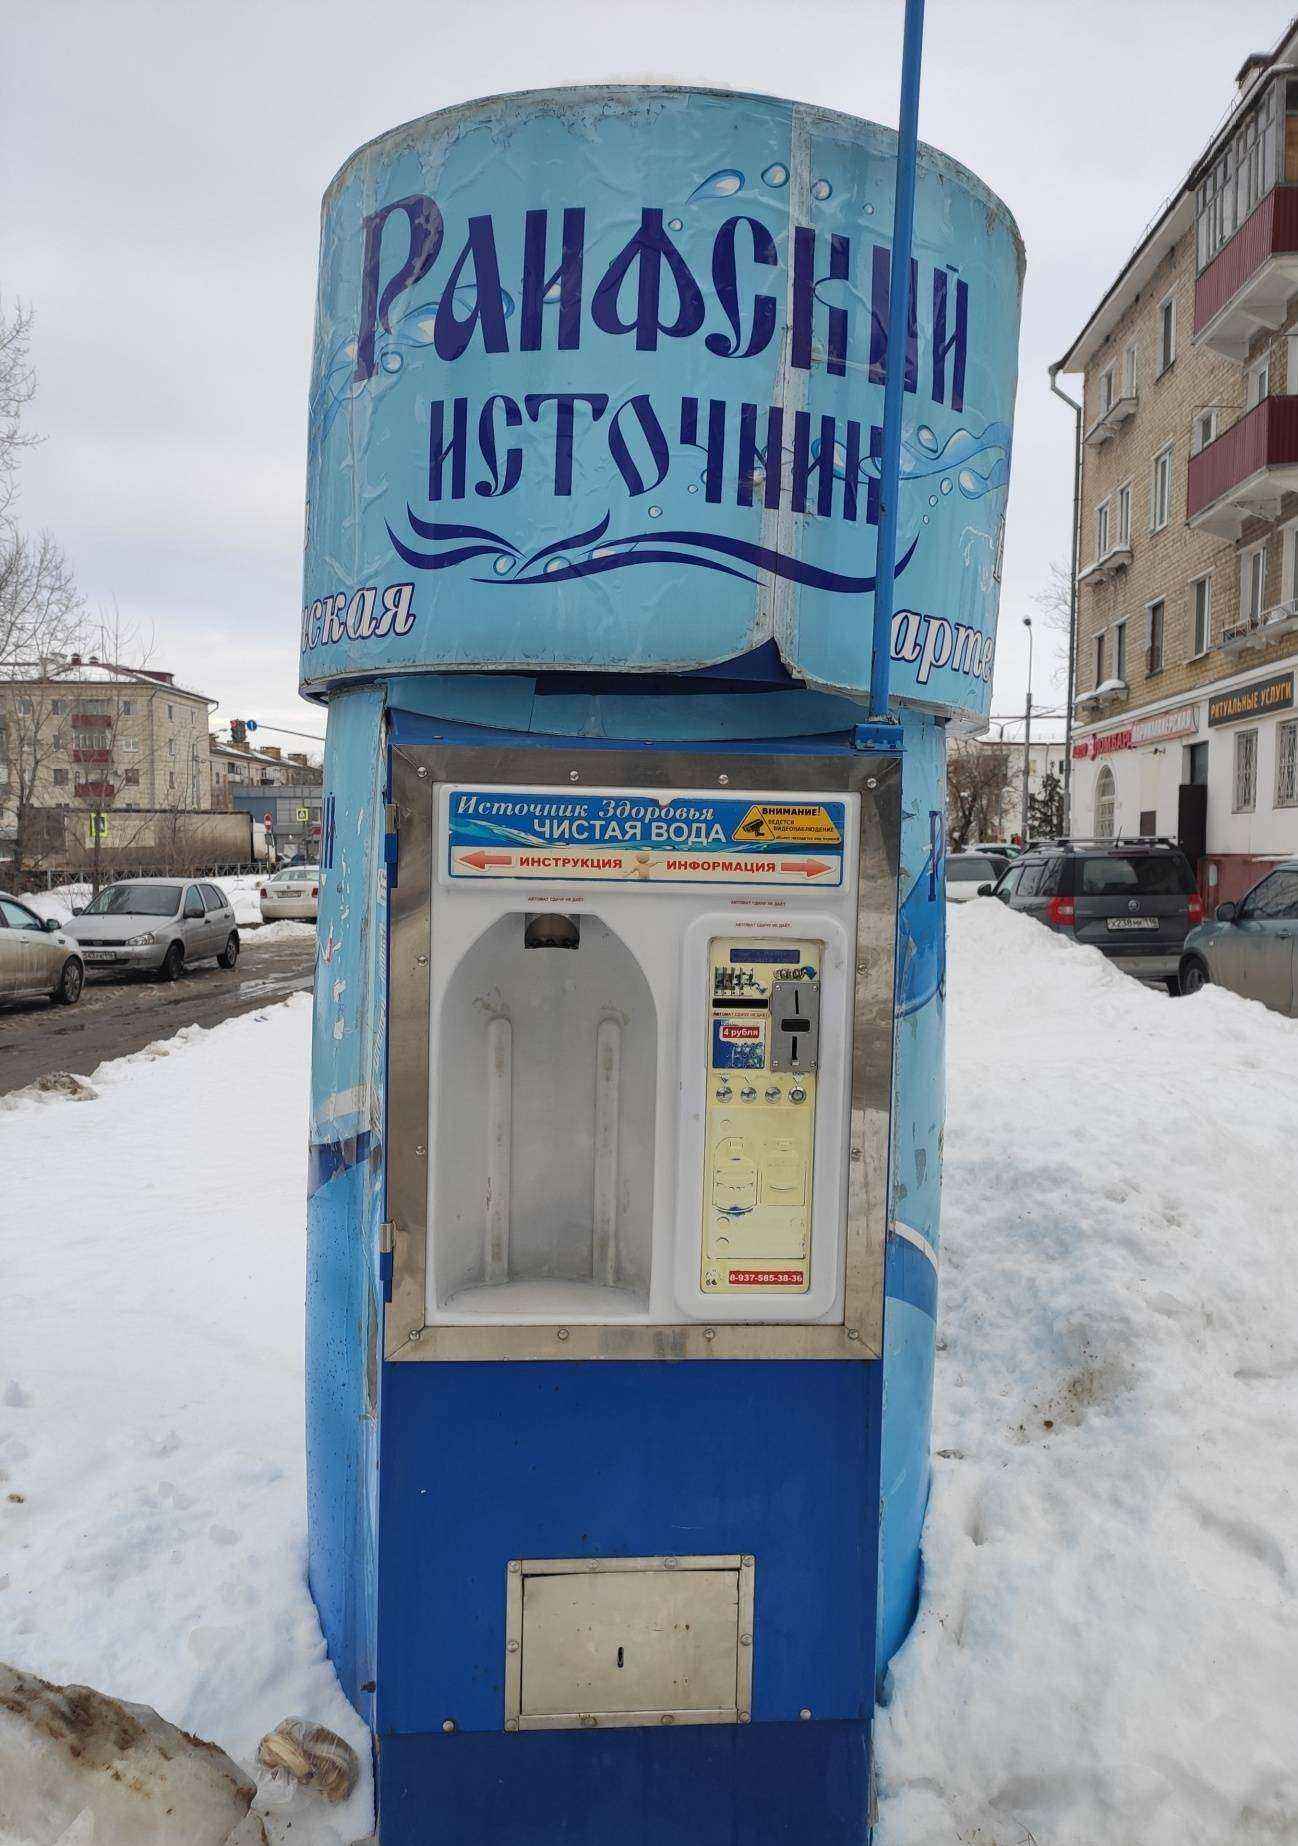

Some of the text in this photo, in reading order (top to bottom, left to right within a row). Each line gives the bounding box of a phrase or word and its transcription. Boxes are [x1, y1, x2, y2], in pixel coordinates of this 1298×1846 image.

[1261, 681, 1292, 706] УСЛУГИ
[457, 796, 714, 823] Источник Здоровья
[761, 806, 821, 817] ВНИМАНИЕ!
[533, 818, 727, 845] ЧИСТАЯ ВОДА
[519, 856, 776, 873] ИНСТРУКЦИЯ ИНФОРМАЦИЯ
[723, 1028, 758, 1038] 4 рубля
